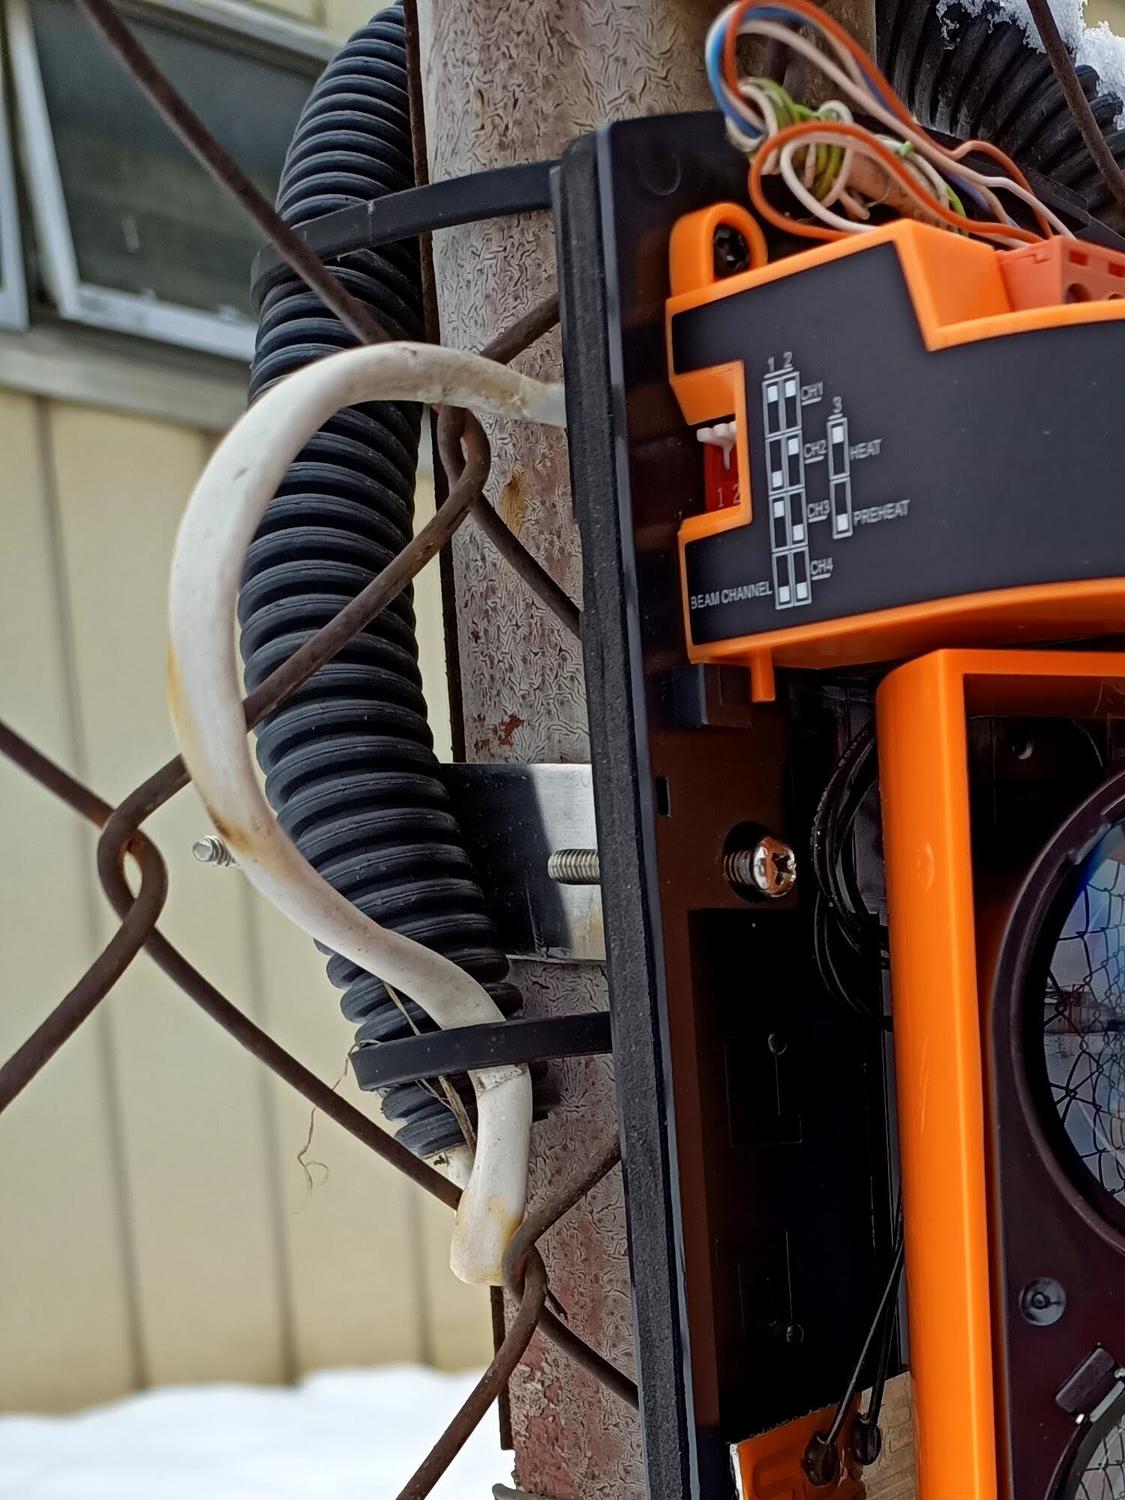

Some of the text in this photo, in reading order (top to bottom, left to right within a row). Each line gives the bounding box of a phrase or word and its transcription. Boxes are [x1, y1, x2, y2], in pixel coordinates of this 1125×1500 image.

[767, 351, 794, 372] 1 2
[801, 382, 824, 400] CH1
[832, 396, 843, 414] 3
[804, 439, 827, 459] CH2
[850, 439, 882, 461] HEAT
[807, 500, 830, 518] CH3
[854, 500, 911, 525] PREHEAT
[810, 557, 834, 575] CH4
[722, 581, 774, 603] CHANNEL
